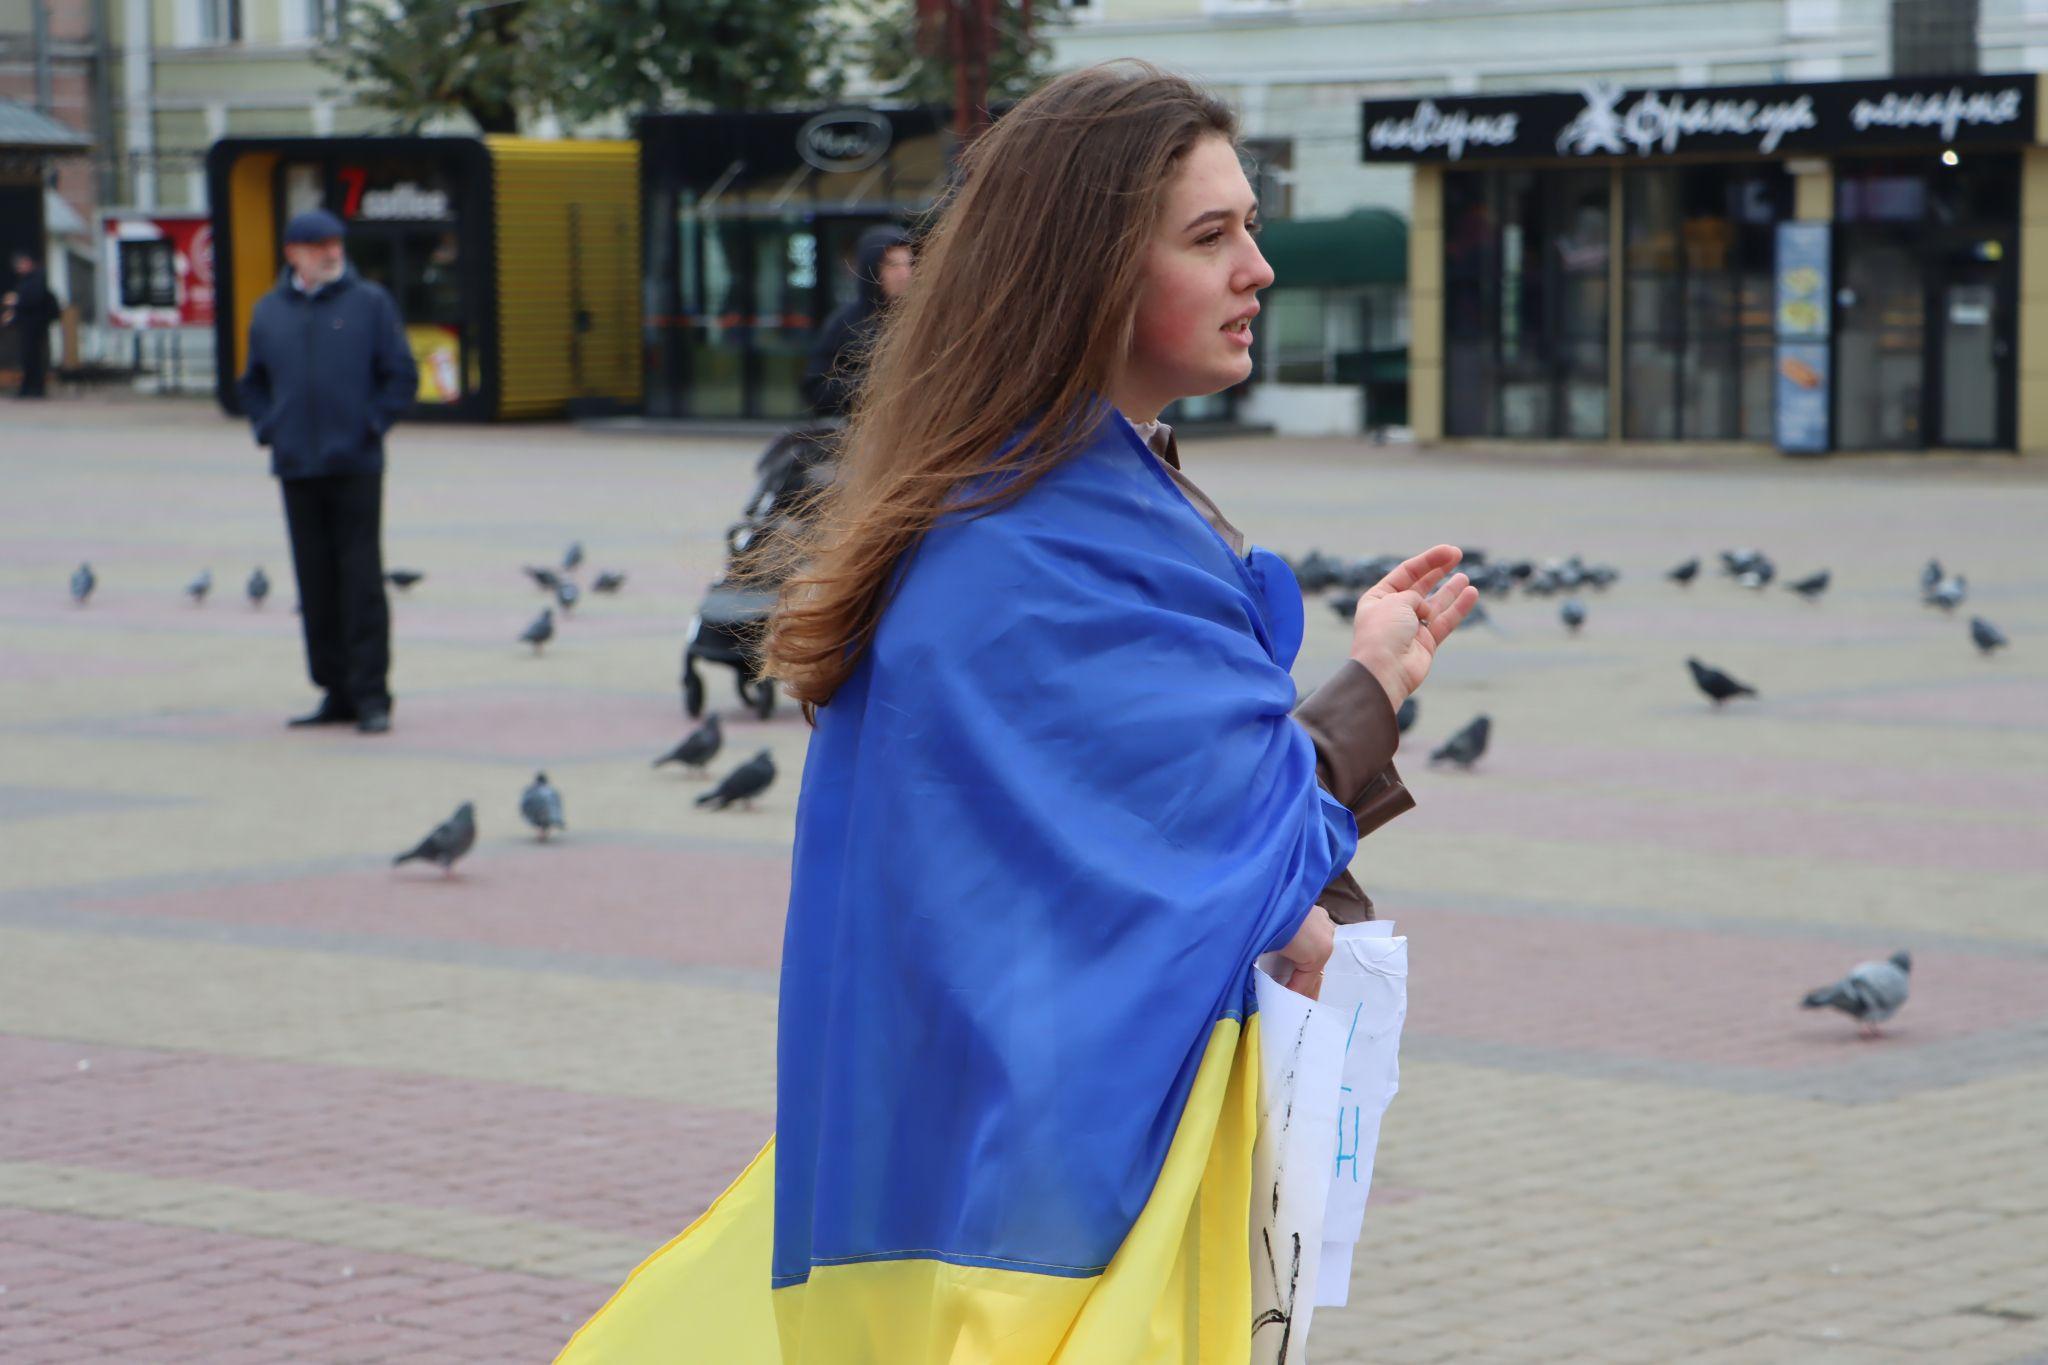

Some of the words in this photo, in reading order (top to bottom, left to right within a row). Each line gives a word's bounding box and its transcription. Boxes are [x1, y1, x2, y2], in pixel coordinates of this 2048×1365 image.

[1850, 86, 2021, 142] пекарня
[339, 166, 367, 219] 7
[361, 181, 448, 219] coffee
